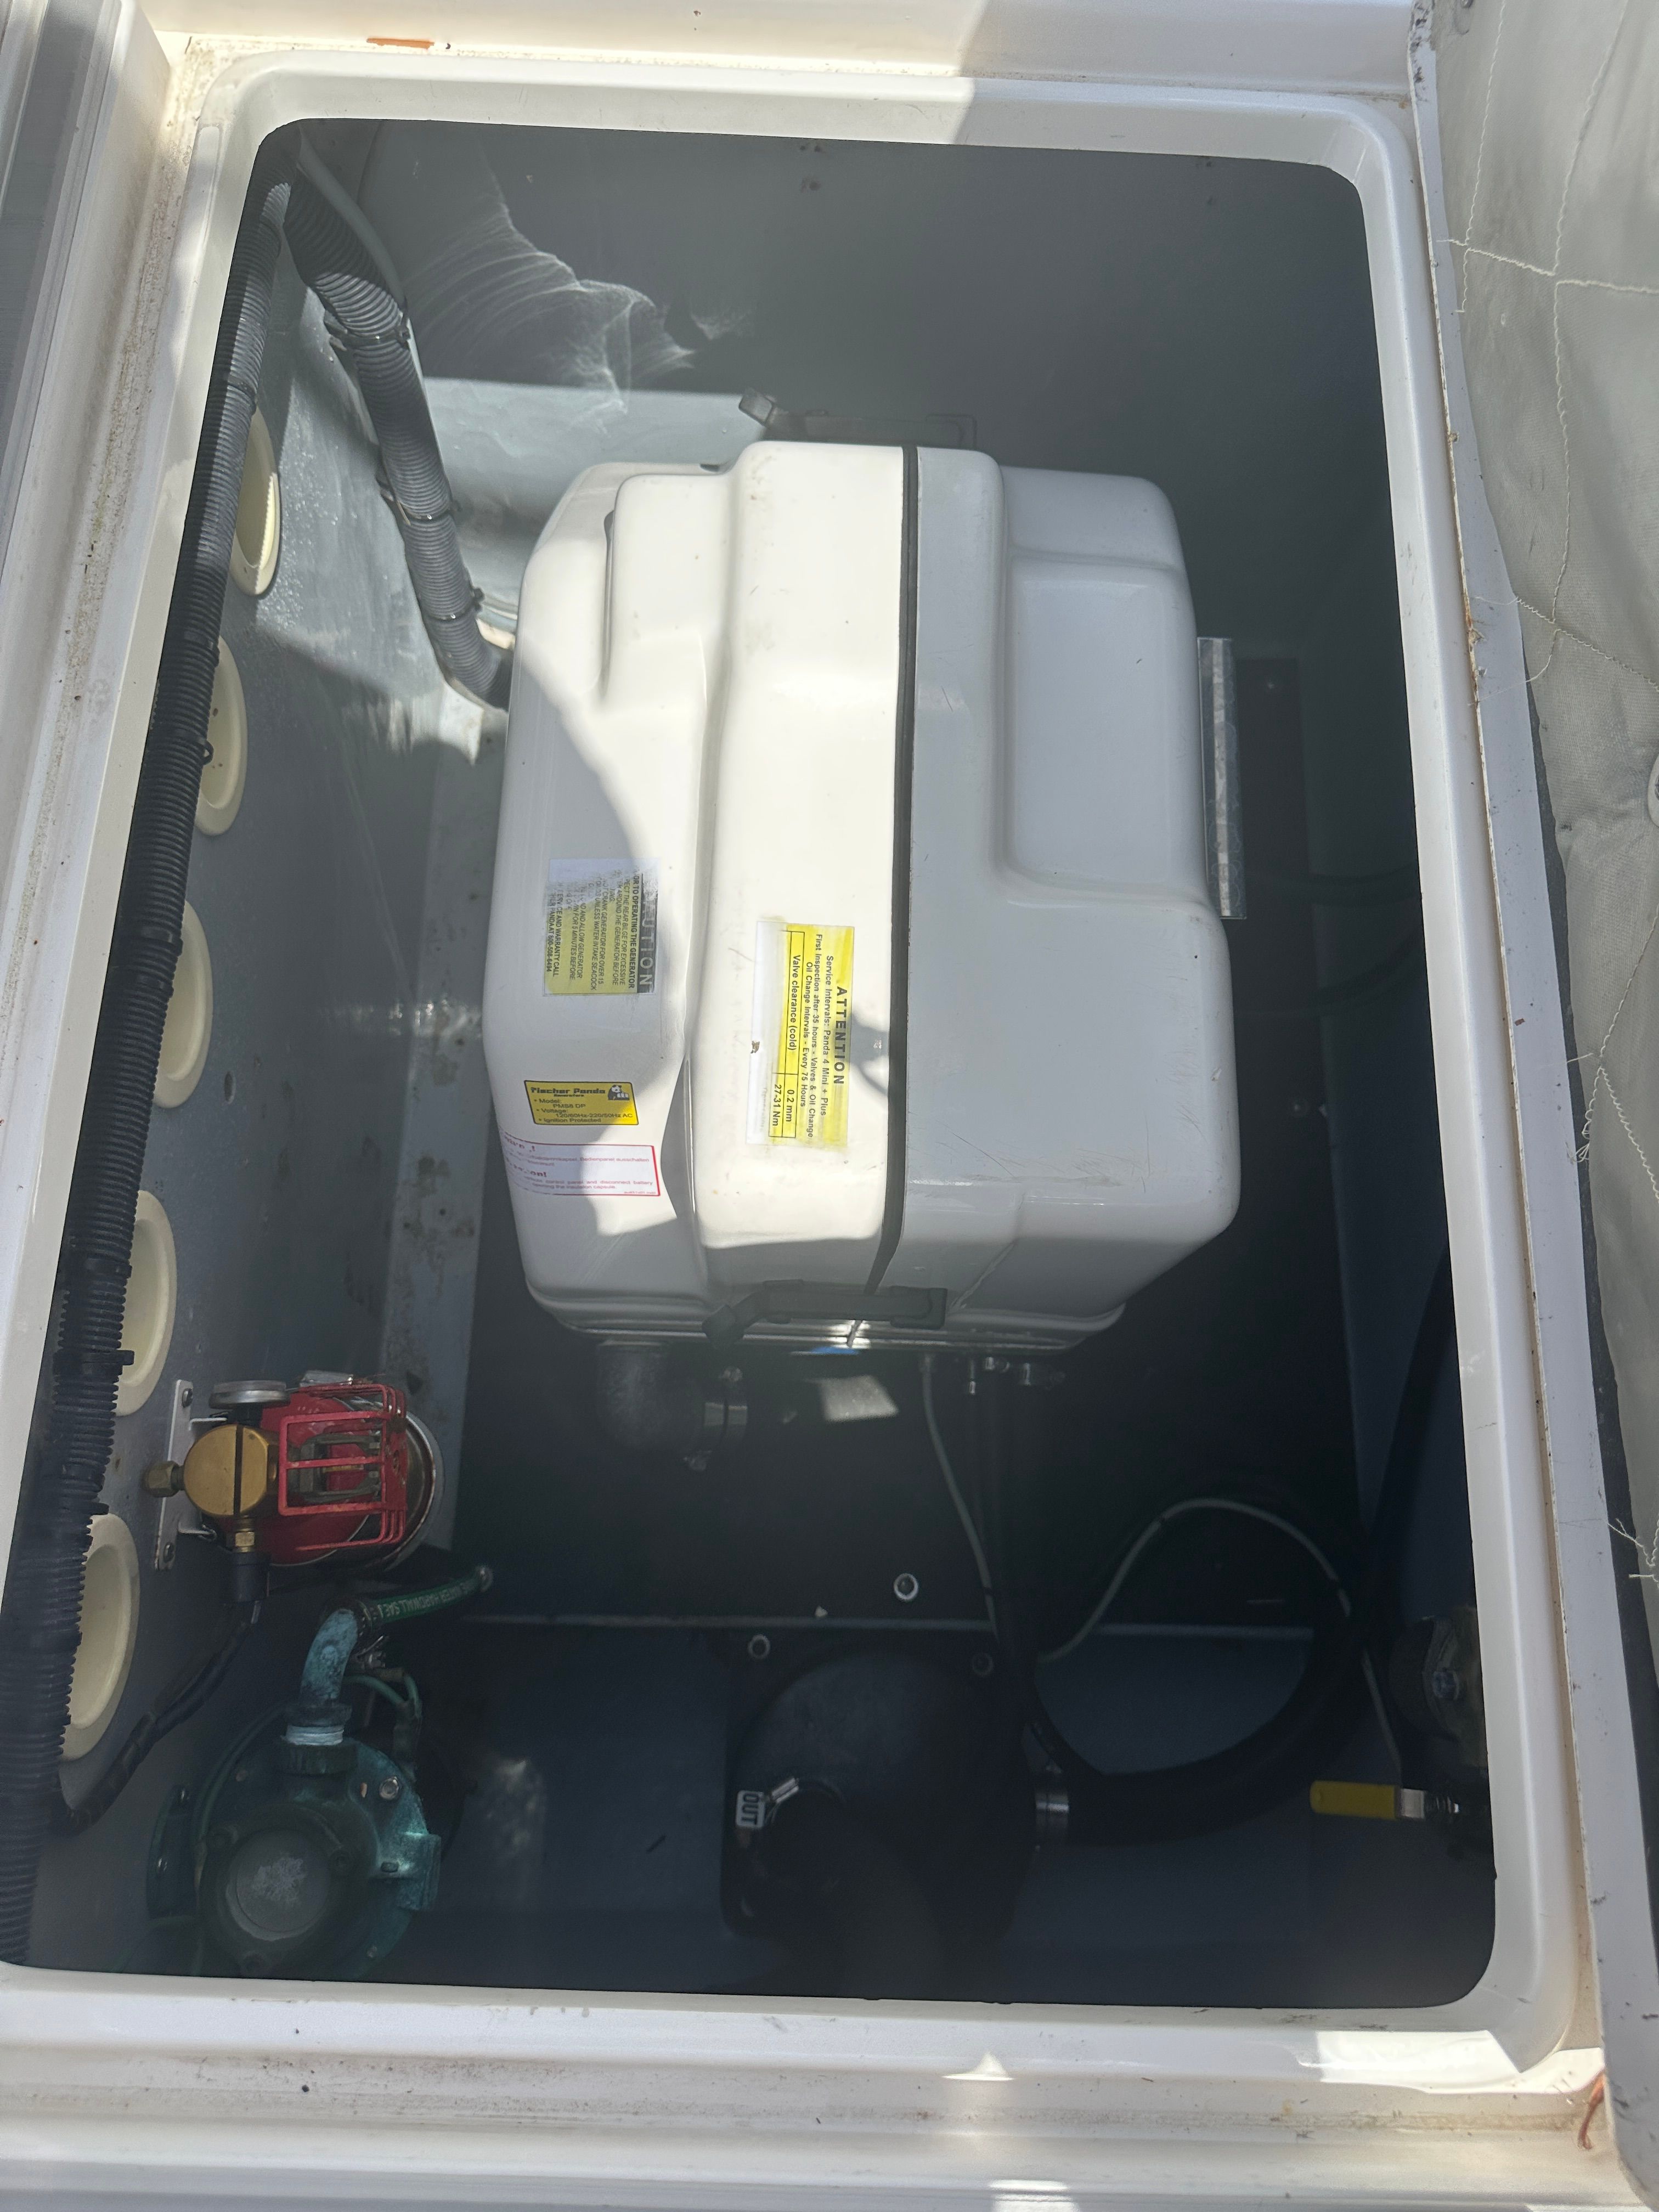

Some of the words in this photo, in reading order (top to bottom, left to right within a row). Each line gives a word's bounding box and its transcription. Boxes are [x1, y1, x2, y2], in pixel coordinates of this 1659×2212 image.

[633, 885, 639, 894] TO
[640, 901, 655, 985] UTION
[813, 954, 822, 991] Inspection
[804, 975, 812, 1003] Change
[791, 981, 799, 1023] clearance
[824, 989, 832, 1026] Intervals:
[813, 1014, 819, 1023] 35
[788, 1026, 798, 1051] (cold)
[834, 986, 847, 1084] ATTENTION
[801, 1048, 809, 1068] Every
[802, 1072, 808, 1081] 75
[773, 1084, 782, 1108] 27-31
[787, 1090, 795, 1102] 0.2
[772, 1111, 781, 1126] Nm
[786, 1105, 793, 1122] mm
[806, 1109, 815, 1137] Change
[742, 1793, 759, 1825] OUT
